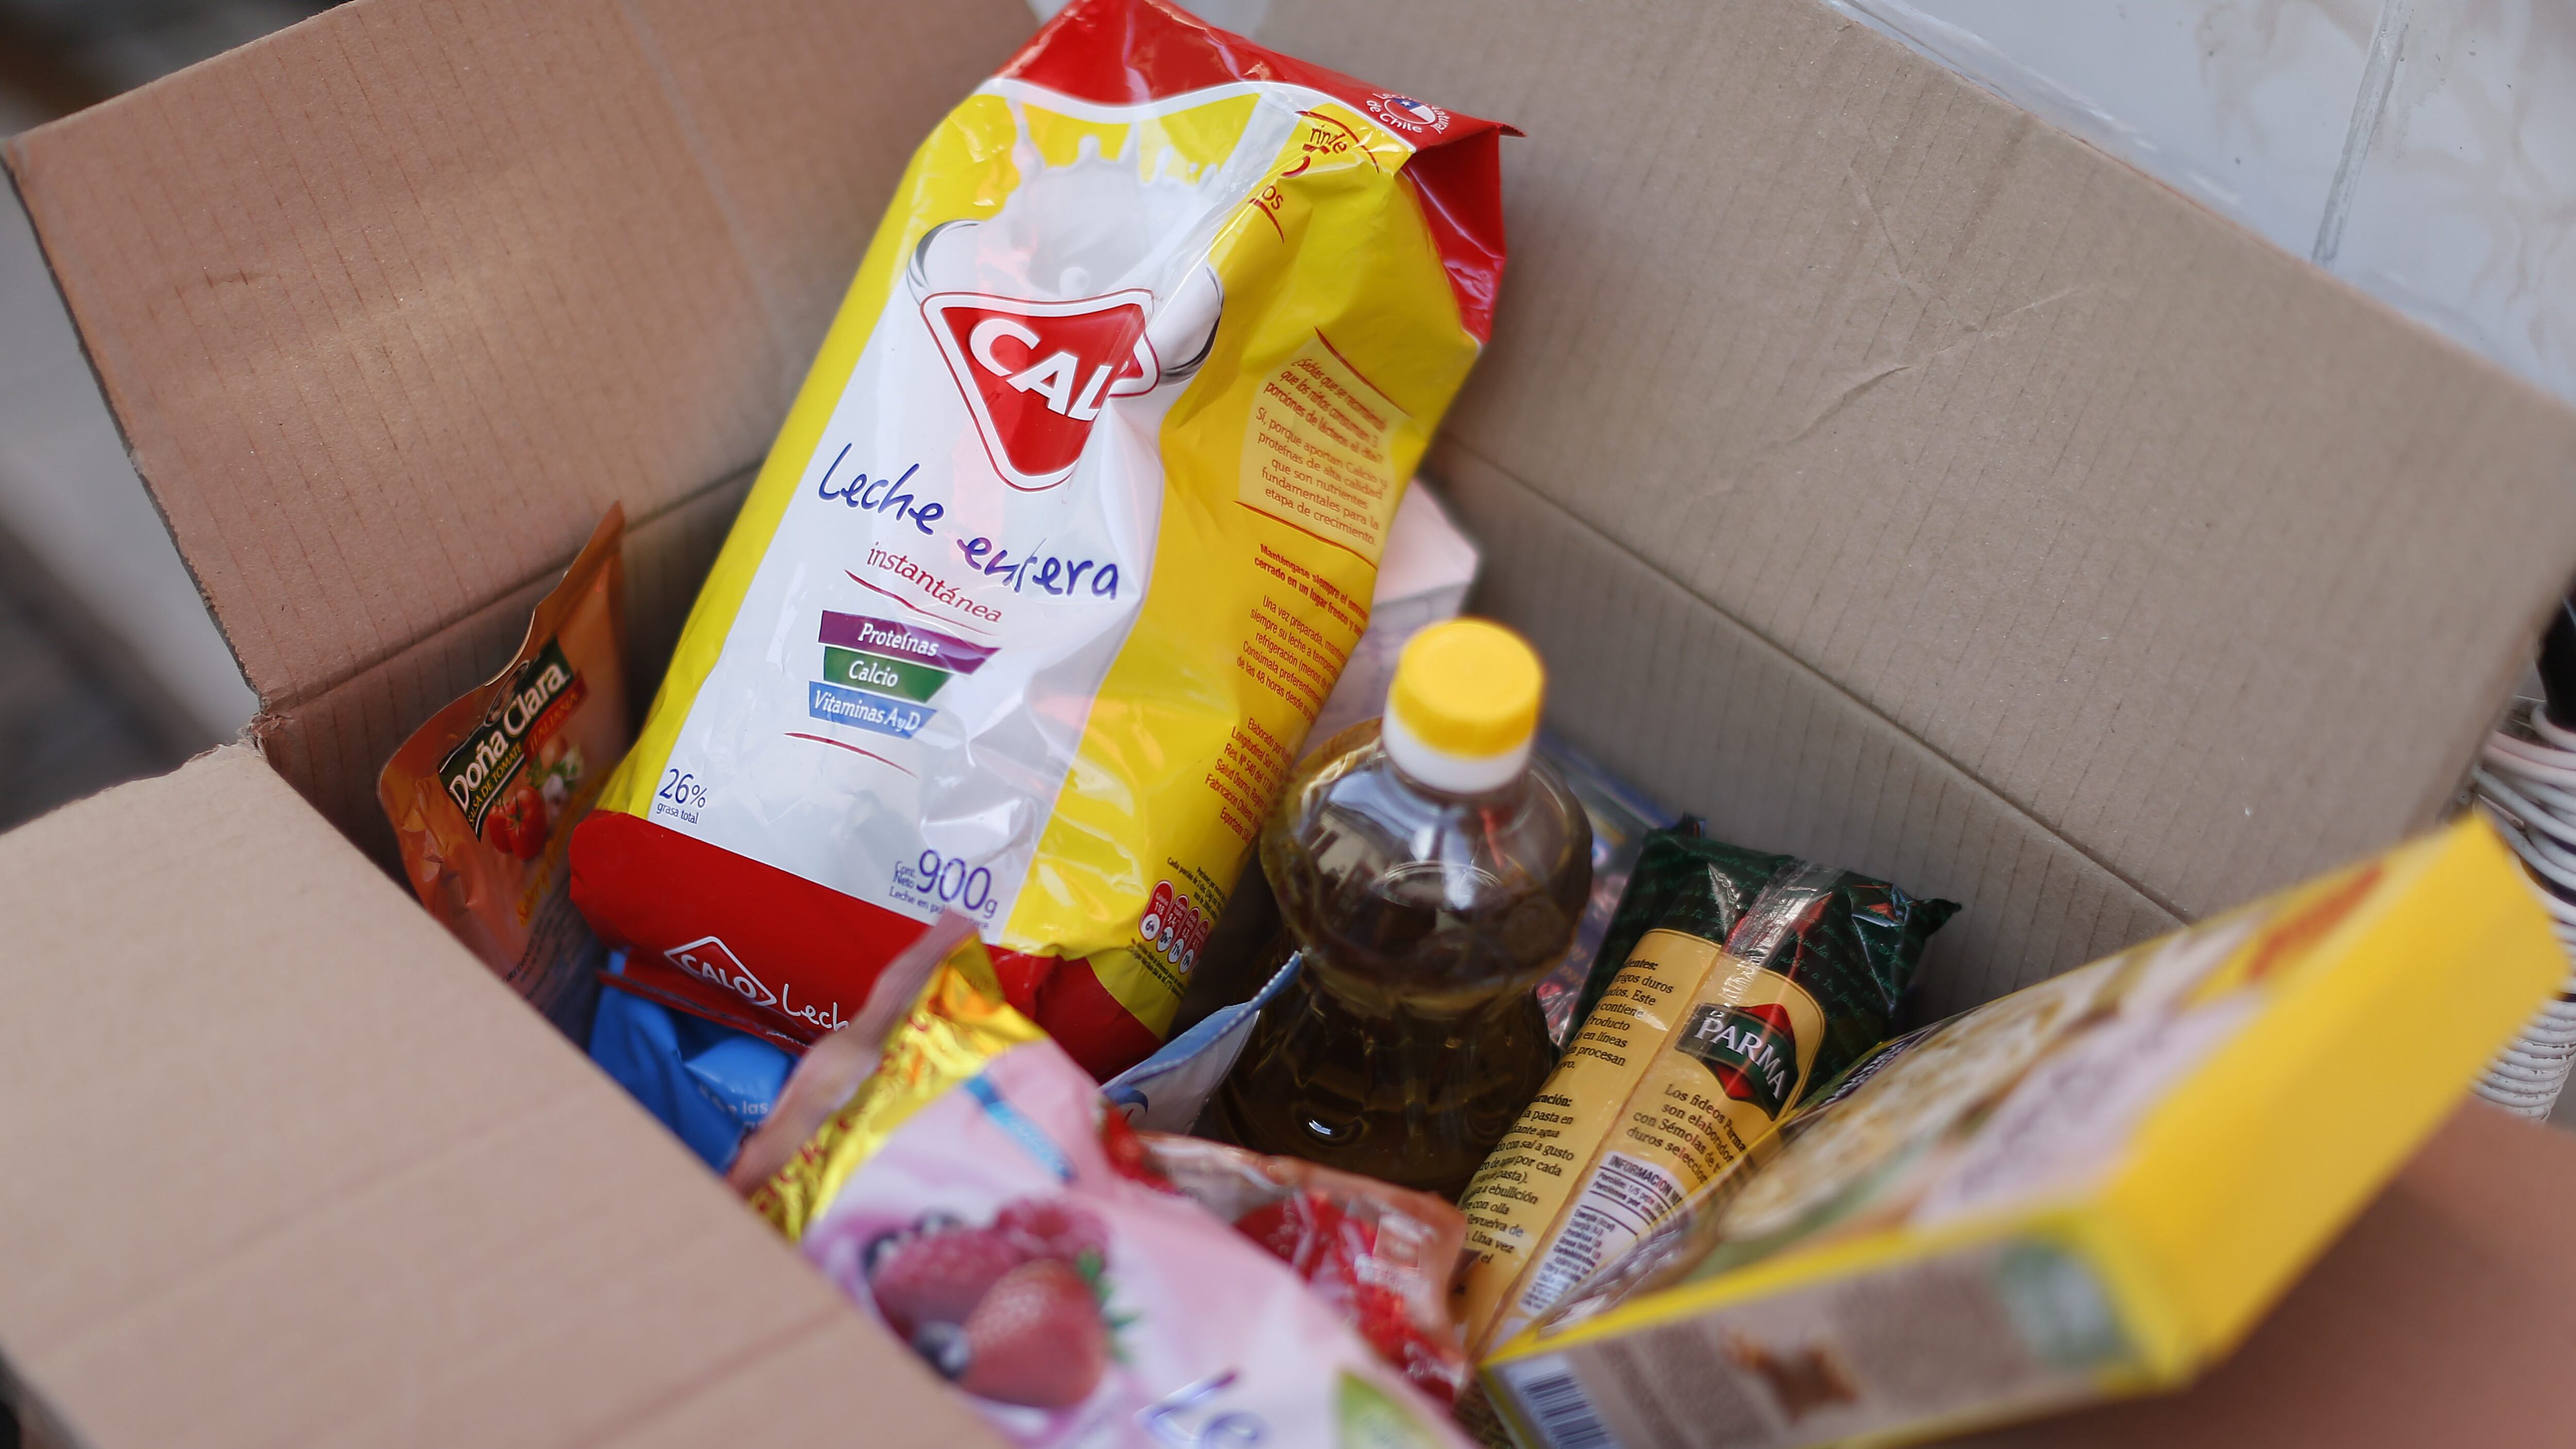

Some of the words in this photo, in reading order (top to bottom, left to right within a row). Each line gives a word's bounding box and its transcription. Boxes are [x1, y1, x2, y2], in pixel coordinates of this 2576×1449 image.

[1366, 100, 1382, 113] de
[1379, 113, 1422, 133] Chile
[969, 318, 1114, 422] CAL
[1279, 370, 1299, 385] que
[1295, 378, 1311, 395] los
[1307, 390, 1331, 412] niños
[1263, 382, 1306, 417] porciones
[1306, 410, 1318, 427] de
[1317, 416, 1349, 447] lácteos
[1256, 407, 1267, 425] Sí,
[1268, 418, 1302, 447] porque
[1303, 442, 1344, 468] aportan
[1345, 461, 1378, 483] Calcio
[1258, 432, 1303, 465] proteínas
[1306, 458, 1321, 471] de
[1323, 466, 1342, 482] alta
[1344, 477, 1383, 500] calidad
[817, 442, 946, 536] Leche
[1262, 466, 1341, 513] fundamentales
[1343, 507, 1367, 526] para
[1369, 516, 1380, 531] la
[1271, 458, 1291, 475] que
[1293, 470, 1313, 485] son
[1316, 479, 1369, 510] nutrientes
[1265, 487, 1294, 509] etapa
[1297, 501, 1311, 517] de
[1313, 511, 1377, 547] crecimiento.
[865, 542, 1004, 625] instantánea
[1260, 543, 1311, 580] Manténgase
[1312, 574, 1341, 600] siempre
[1340, 594, 1348, 605] el
[1254, 557, 1286, 582] cerrado
[1287, 576, 1297, 589] en
[1298, 582, 1309, 596] un
[1309, 587, 1328, 610] lugar
[1328, 601, 1349, 626] fresco
[1348, 619, 1354, 631] y
[1249, 609, 1278, 634] siempre
[1278, 628, 1288, 641] su
[1287, 632, 1307, 654] leche
[1307, 647, 1312, 658] a
[1262, 595, 1277, 613] Una
[1278, 606, 1291, 623] vez
[1290, 616, 1324, 648] preparada,
[857, 622, 939, 657] Proteínas
[1255, 632, 1298, 667] refrigeración
[848, 660, 899, 687] Calcio
[1242, 640, 1279, 675] Consúmala
[1236, 655, 1245, 670] de
[1245, 661, 1256, 678] las
[1256, 669, 1265, 685] 48
[1265, 675, 1285, 698] horas
[1285, 690, 1304, 711] desde
[814, 689, 886, 724] Vitaminas
[449, 730, 509, 815] Doña
[503, 664, 568, 738] Clara
[1247, 717, 1275, 748] Elaborado
[481, 781, 494, 798] DE
[491, 742, 523, 783] TOMATE
[1214, 758, 1235, 781] Salud
[659, 768, 708, 808] 26%
[1204, 773, 1239, 808] Fabricación
[656, 802, 680, 818] grasa
[680, 809, 699, 824] total
[681, 954, 757, 999] CALO
[782, 983, 850, 1032] Lech
[1630, 989, 1656, 1006] Este
[1641, 976, 1674, 994] duros
[1600, 1002, 1645, 1019] contiene
[1575, 1046, 1626, 1067] procesan
[1583, 1031, 1594, 1040] en
[1596, 1031, 1629, 1049] líneas
[1694, 1016, 1786, 1100] PARMA
[742, 1099, 769, 1115] las
[1530, 1110, 1560, 1123] pasta
[1560, 1115, 1574, 1125] en
[1664, 1083, 1689, 1102] Los
[1689, 1093, 1726, 1124] fideos
[1724, 1118, 1748, 1153] Parma
[1505, 1140, 1520, 1151] con
[1519, 1139, 1537, 1149] sal
[1534, 1142, 1543, 1151] a
[1541, 1144, 1575, 1161] gusto
[1536, 1128, 1560, 1138] agua
[1626, 1126, 1664, 1148] duros
[1633, 1111, 1657, 1127] con
[1657, 1117, 1707, 1155] Sémolas
[1705, 1151, 1716, 1167] de
[1661, 1103, 1686, 1120] son
[1688, 1114, 1734, 1163] elaborados
[1514, 1155, 1536, 1167] por
[1535, 1160, 1562, 1177] cada
[1471, 1199, 1489, 1209] con
[1489, 1202, 1510, 1215] olla
[1488, 1183, 1539, 1205] ebullición
[1471, 1230, 1494, 1246] Una
[1495, 1239, 1515, 1254] vez
[1509, 1224, 1524, 1237] de
[1480, 1253, 1494, 1264] el
